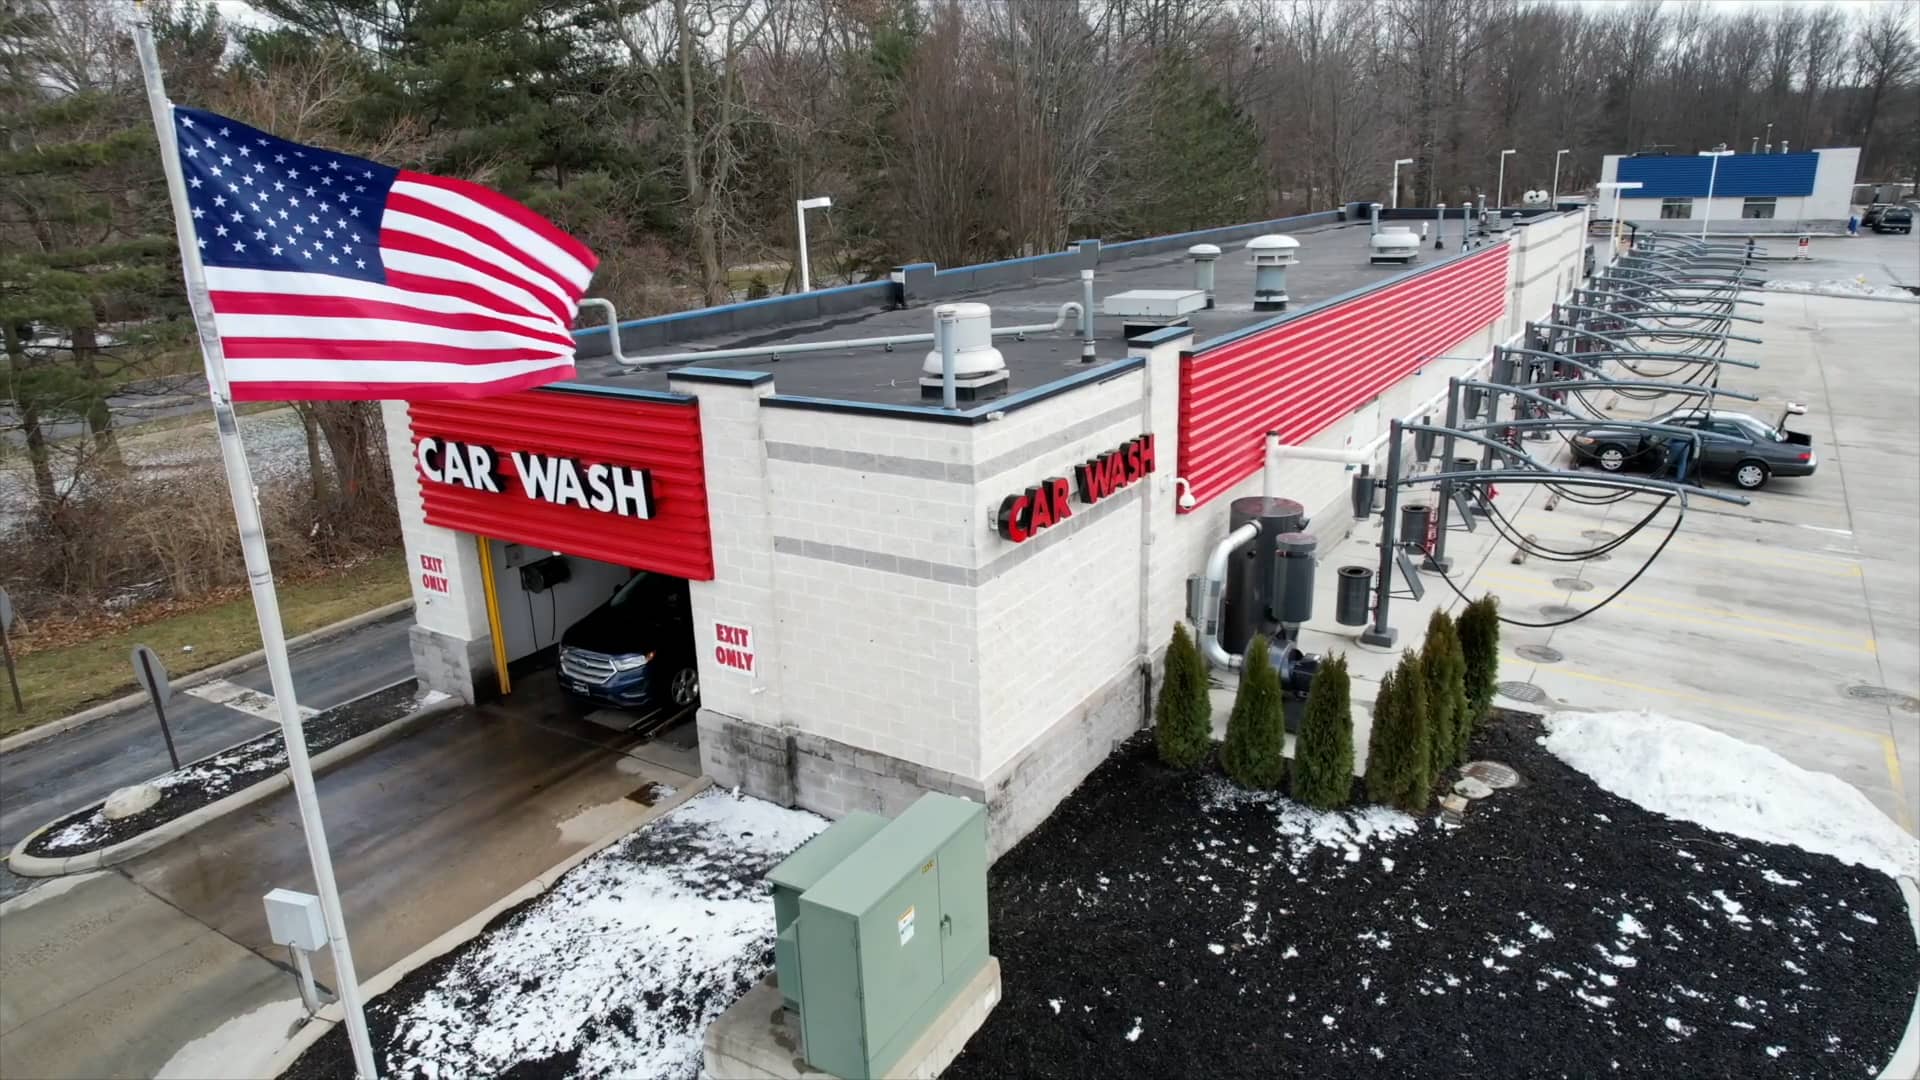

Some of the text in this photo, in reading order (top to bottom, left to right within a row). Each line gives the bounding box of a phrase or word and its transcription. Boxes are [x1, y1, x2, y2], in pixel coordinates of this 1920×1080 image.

[417, 437, 653, 520] CAR WASH
[998, 433, 1156, 543] CAR WASH
[420, 554, 443, 573] EXIT
[422, 573, 448, 593] ONLY
[715, 623, 749, 648] EXIT
[715, 645, 754, 671] ONLY
